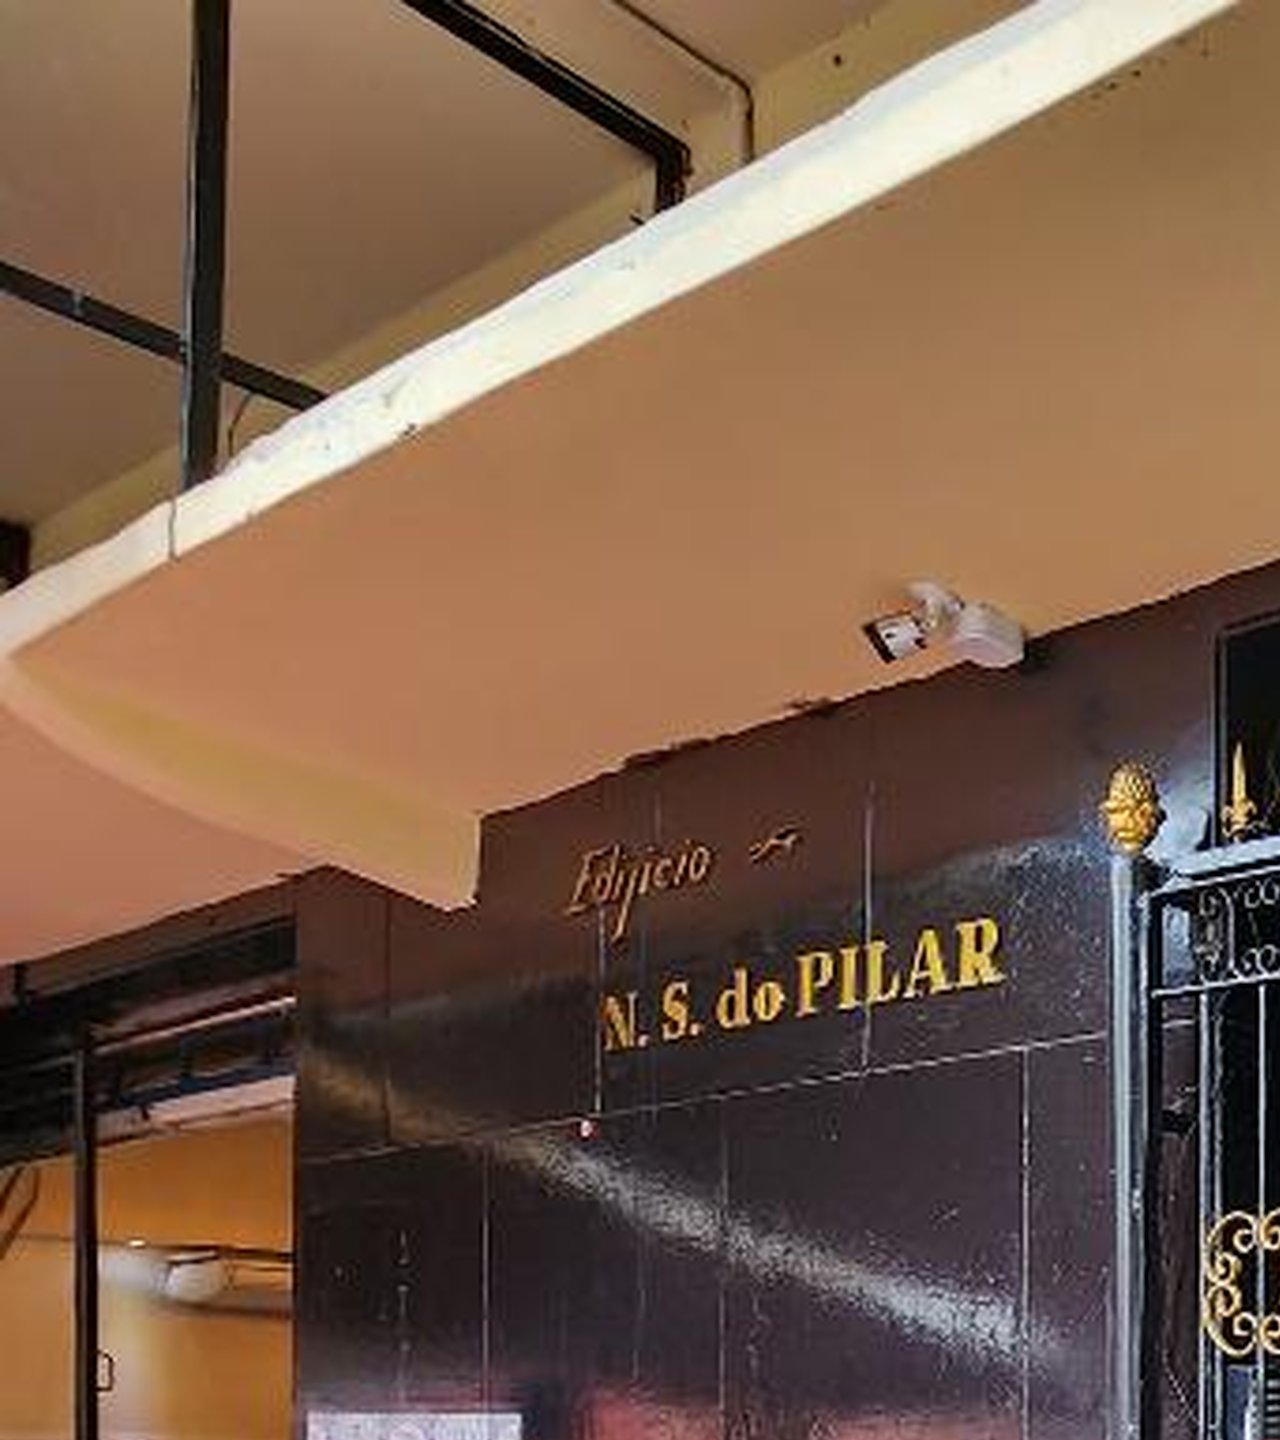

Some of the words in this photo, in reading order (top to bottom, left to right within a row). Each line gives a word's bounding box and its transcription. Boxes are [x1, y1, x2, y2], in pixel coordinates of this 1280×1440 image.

[604, 990, 651, 1051] N.
[662, 982, 700, 1041] S.
[716, 967, 786, 1030] do
[795, 916, 1007, 1018] PILAR
